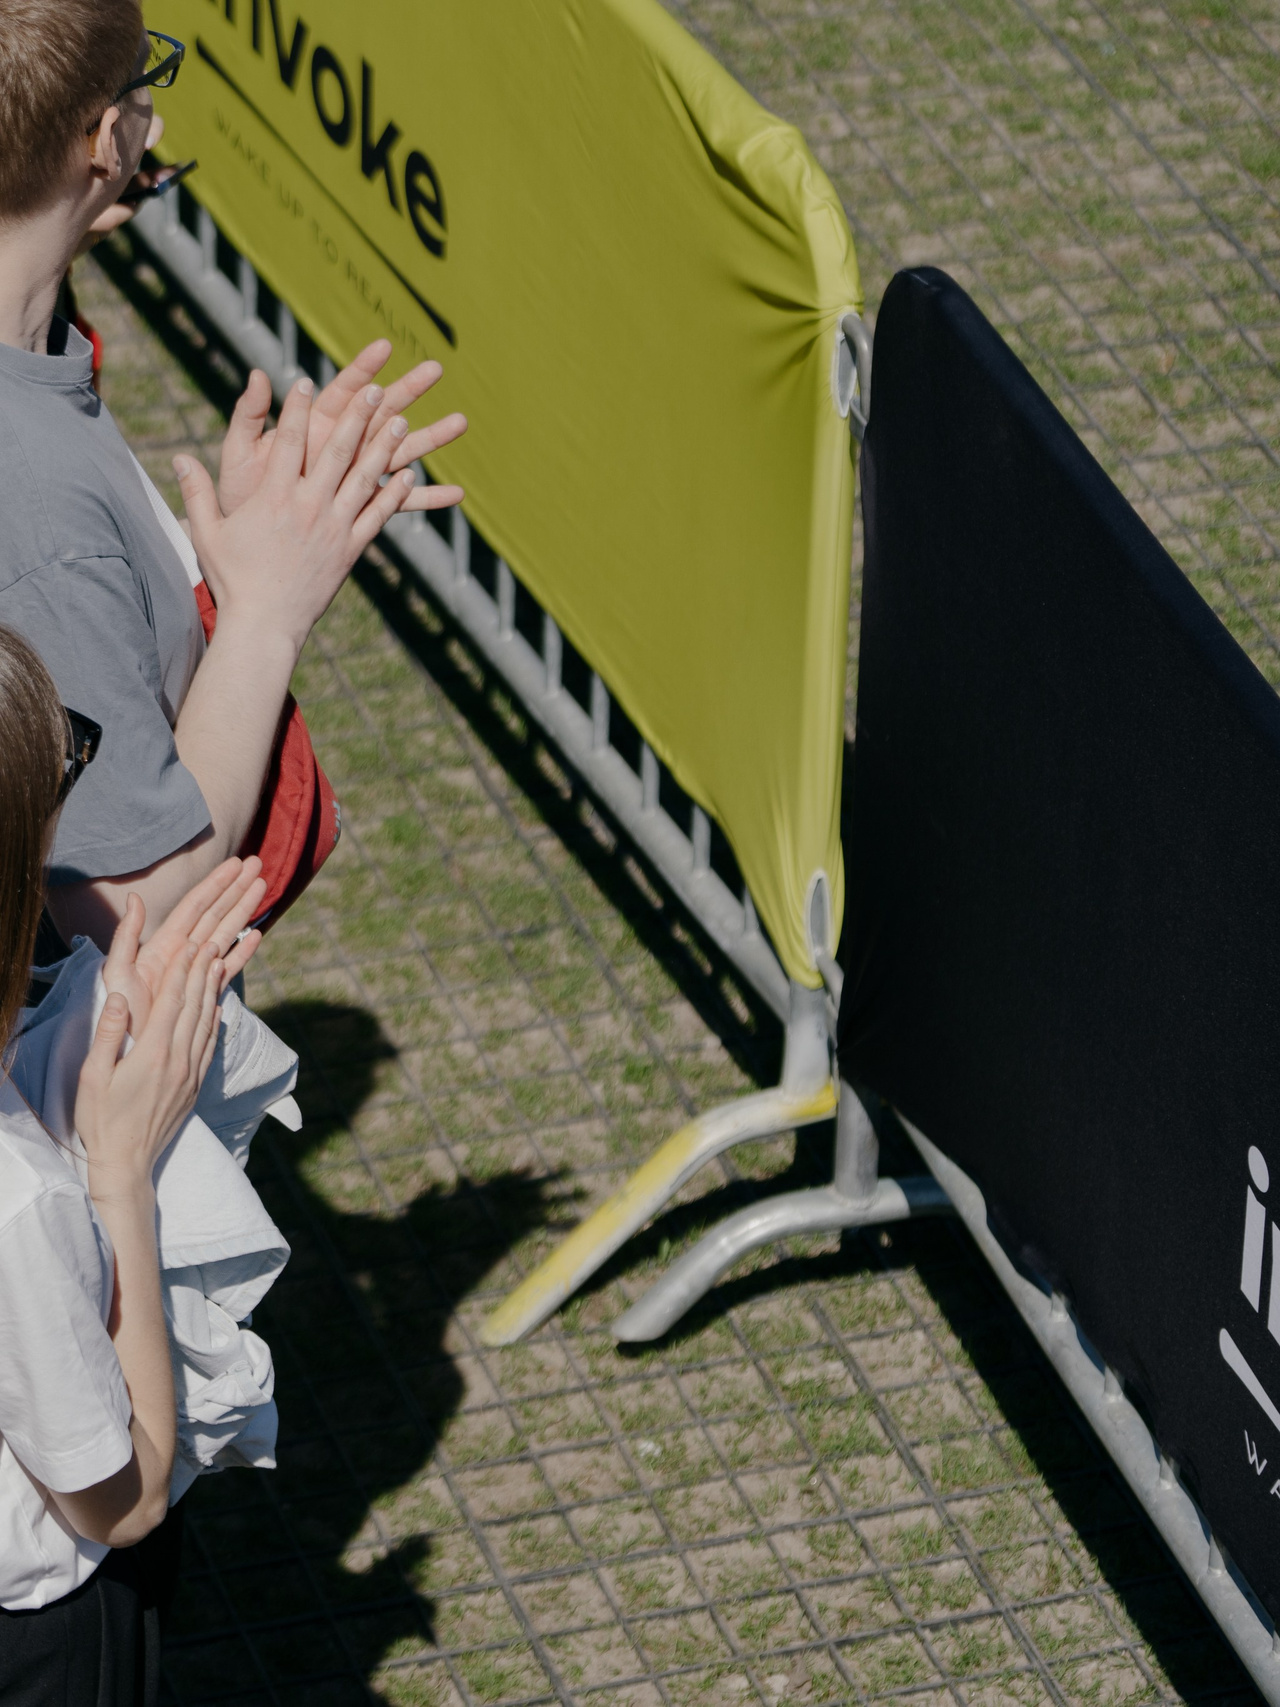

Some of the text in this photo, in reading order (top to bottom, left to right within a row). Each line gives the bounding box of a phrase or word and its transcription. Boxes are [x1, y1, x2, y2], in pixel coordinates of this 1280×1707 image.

[213, 106, 270, 188] WAKE
[280, 182, 304, 218] UP
[312, 217, 338, 265] TO
